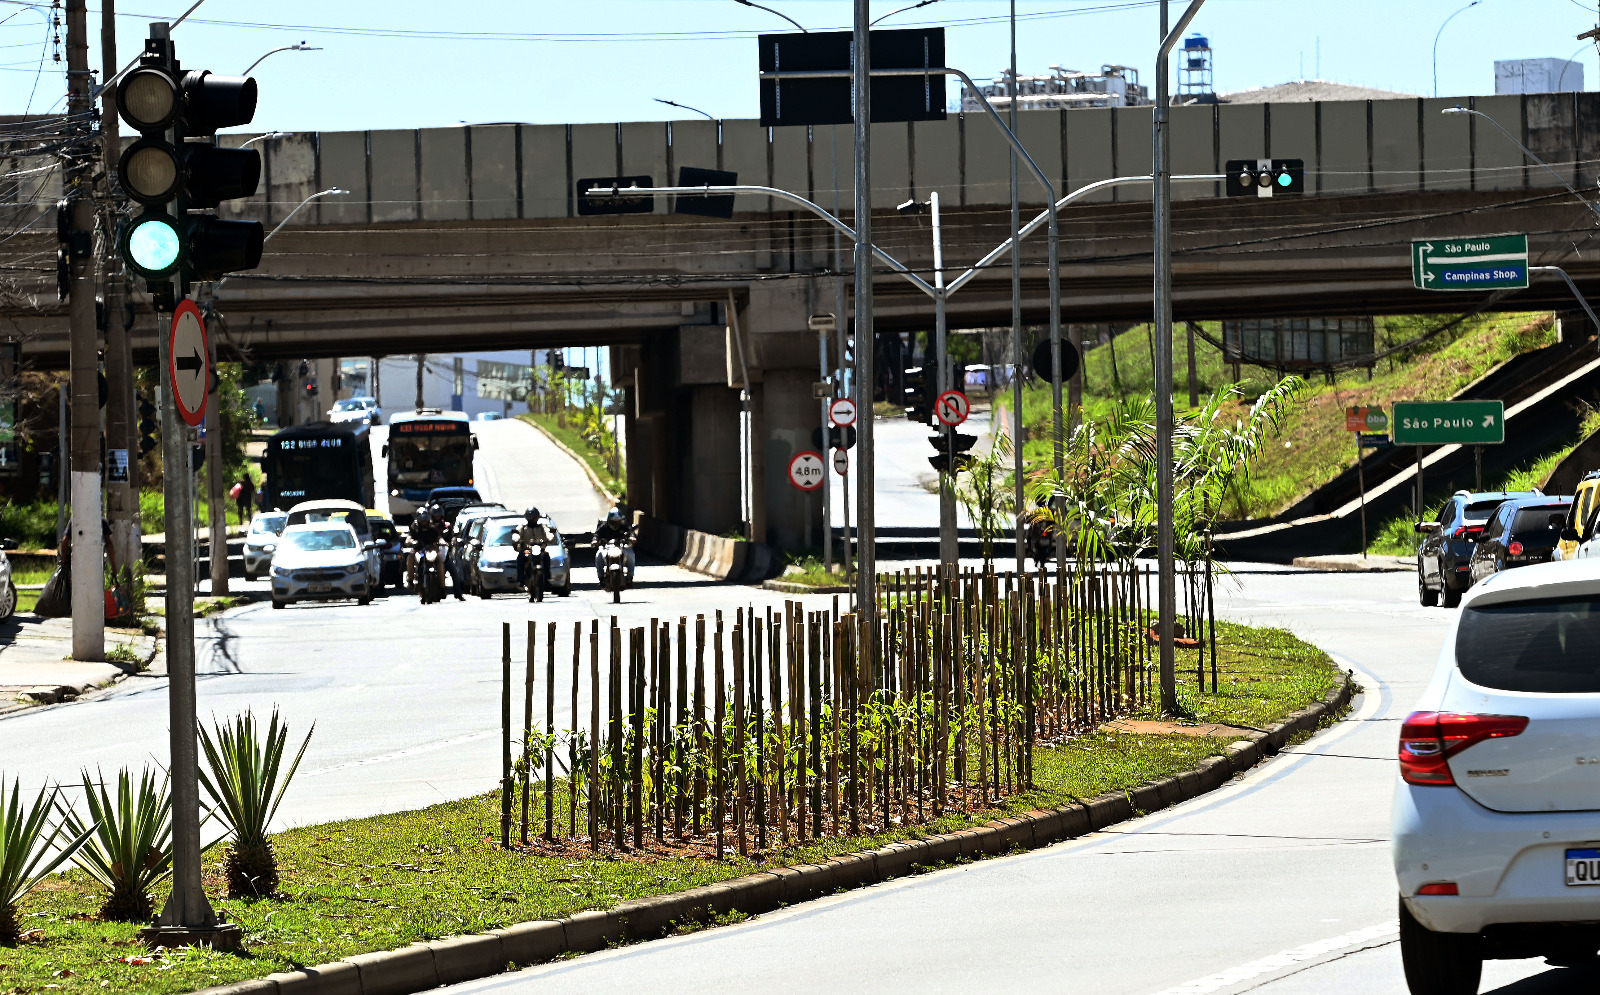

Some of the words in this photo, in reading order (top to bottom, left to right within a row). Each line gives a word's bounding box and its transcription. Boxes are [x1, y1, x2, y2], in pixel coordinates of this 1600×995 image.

[1444, 244, 1462, 253] São
[1464, 242, 1490, 251] Paulo
[1445, 272, 1490, 283] Campinas
[1493, 268, 1518, 280] Shop.
[1402, 416, 1429, 429] São
[1433, 416, 1474, 429] Paulo
